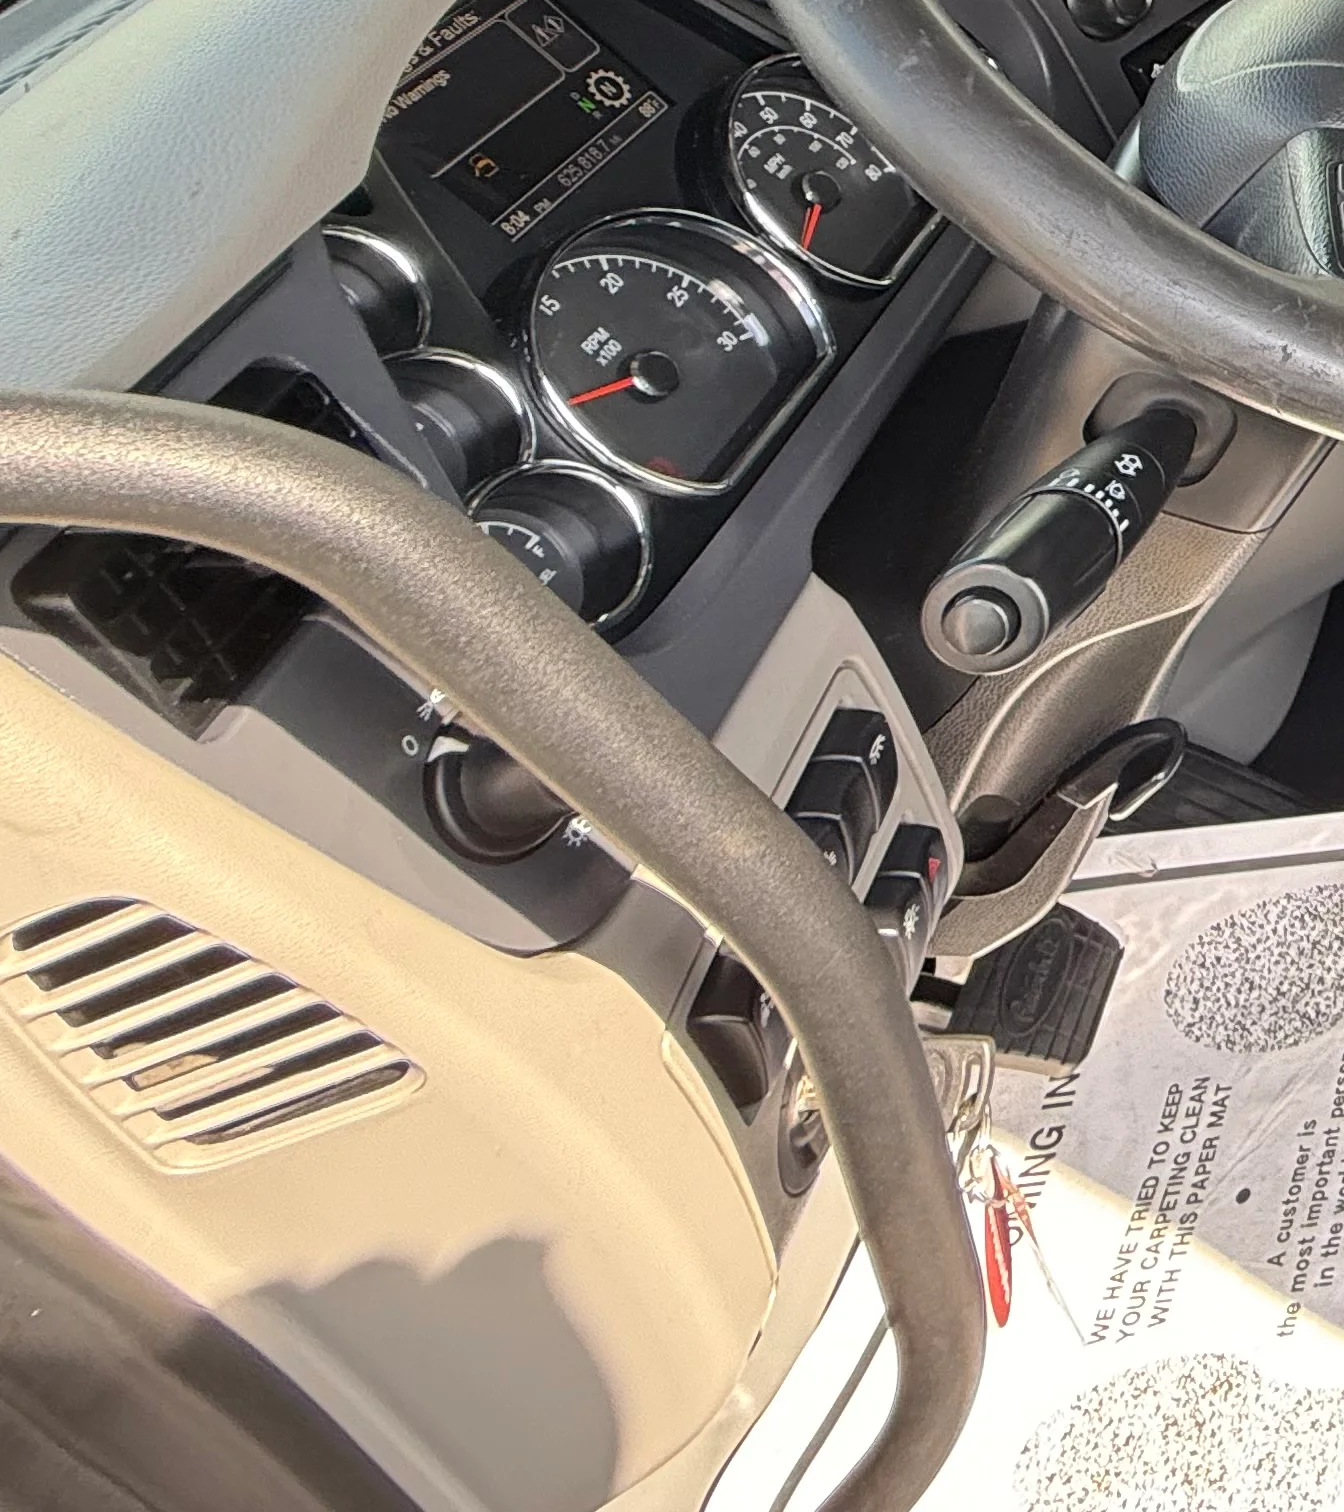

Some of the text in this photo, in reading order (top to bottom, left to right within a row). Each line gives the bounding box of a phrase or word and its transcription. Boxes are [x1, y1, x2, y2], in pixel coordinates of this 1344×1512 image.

[577, 97, 597, 114] N
[759, 106, 779, 125] 50
[799, 112, 818, 129] 60
[835, 131, 854, 149] 70
[864, 164, 882, 182] 80
[599, 272, 625, 295] 20
[538, 294, 562, 316] 15
[666, 285, 690, 308] 25
[580, 326, 611, 356] RPM
[716, 331, 739, 352] 30
[531, 544, 545, 558] F
[1041, 1072, 1081, 1111] IN
[1300, 1126, 1341, 1229] important
[1266, 1119, 1317, 1268] A customer is
[1087, 1083, 1183, 1345] WE HAVE TRIED TO KEEP
[1115, 1076, 1211, 1344] YOUR CARPETING CLEAN
[1147, 1083, 1233, 1328] WITH THIS PAPER MAT
[1320, 1222, 1344, 1258] the
[1290, 1235, 1316, 1293] most
[1313, 1266, 1336, 1289] in
[1276, 1301, 1301, 1338] the
